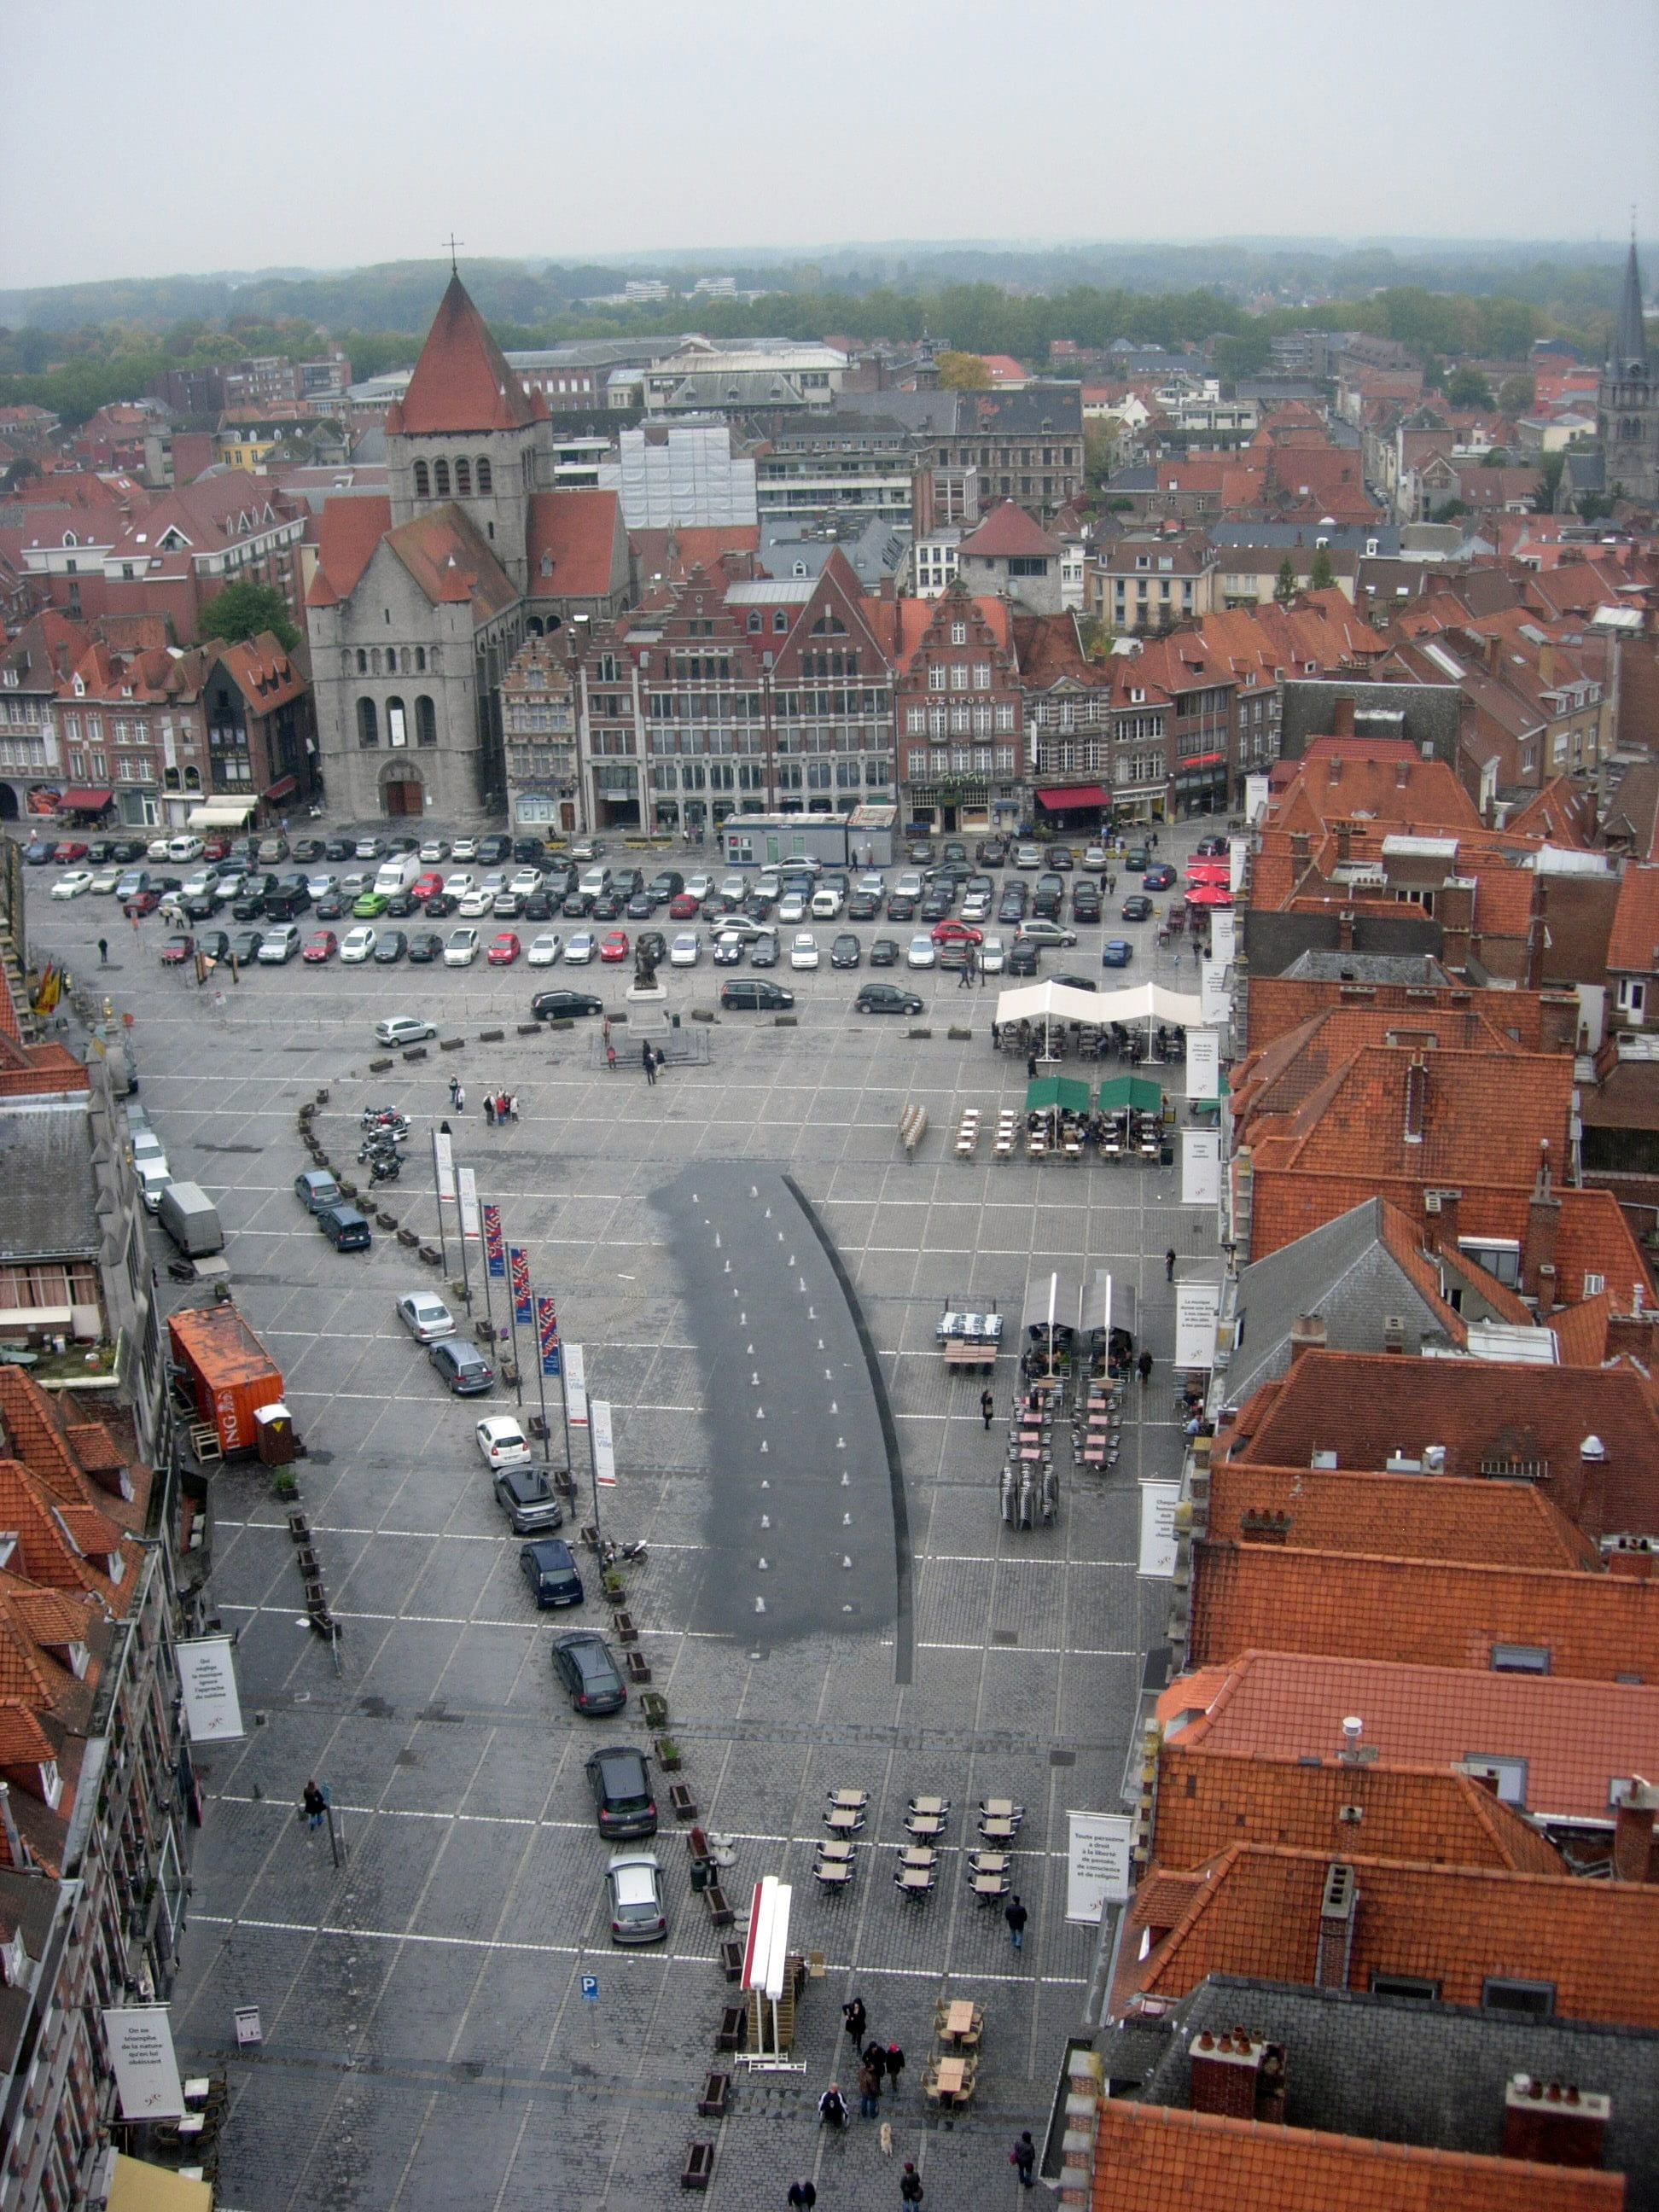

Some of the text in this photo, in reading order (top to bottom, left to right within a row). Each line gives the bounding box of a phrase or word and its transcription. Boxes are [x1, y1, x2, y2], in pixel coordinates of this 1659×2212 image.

[924, 696, 996, 706] L'Europe
[223, 1416, 241, 1449] ING
[583, 1977, 596, 1992] P
